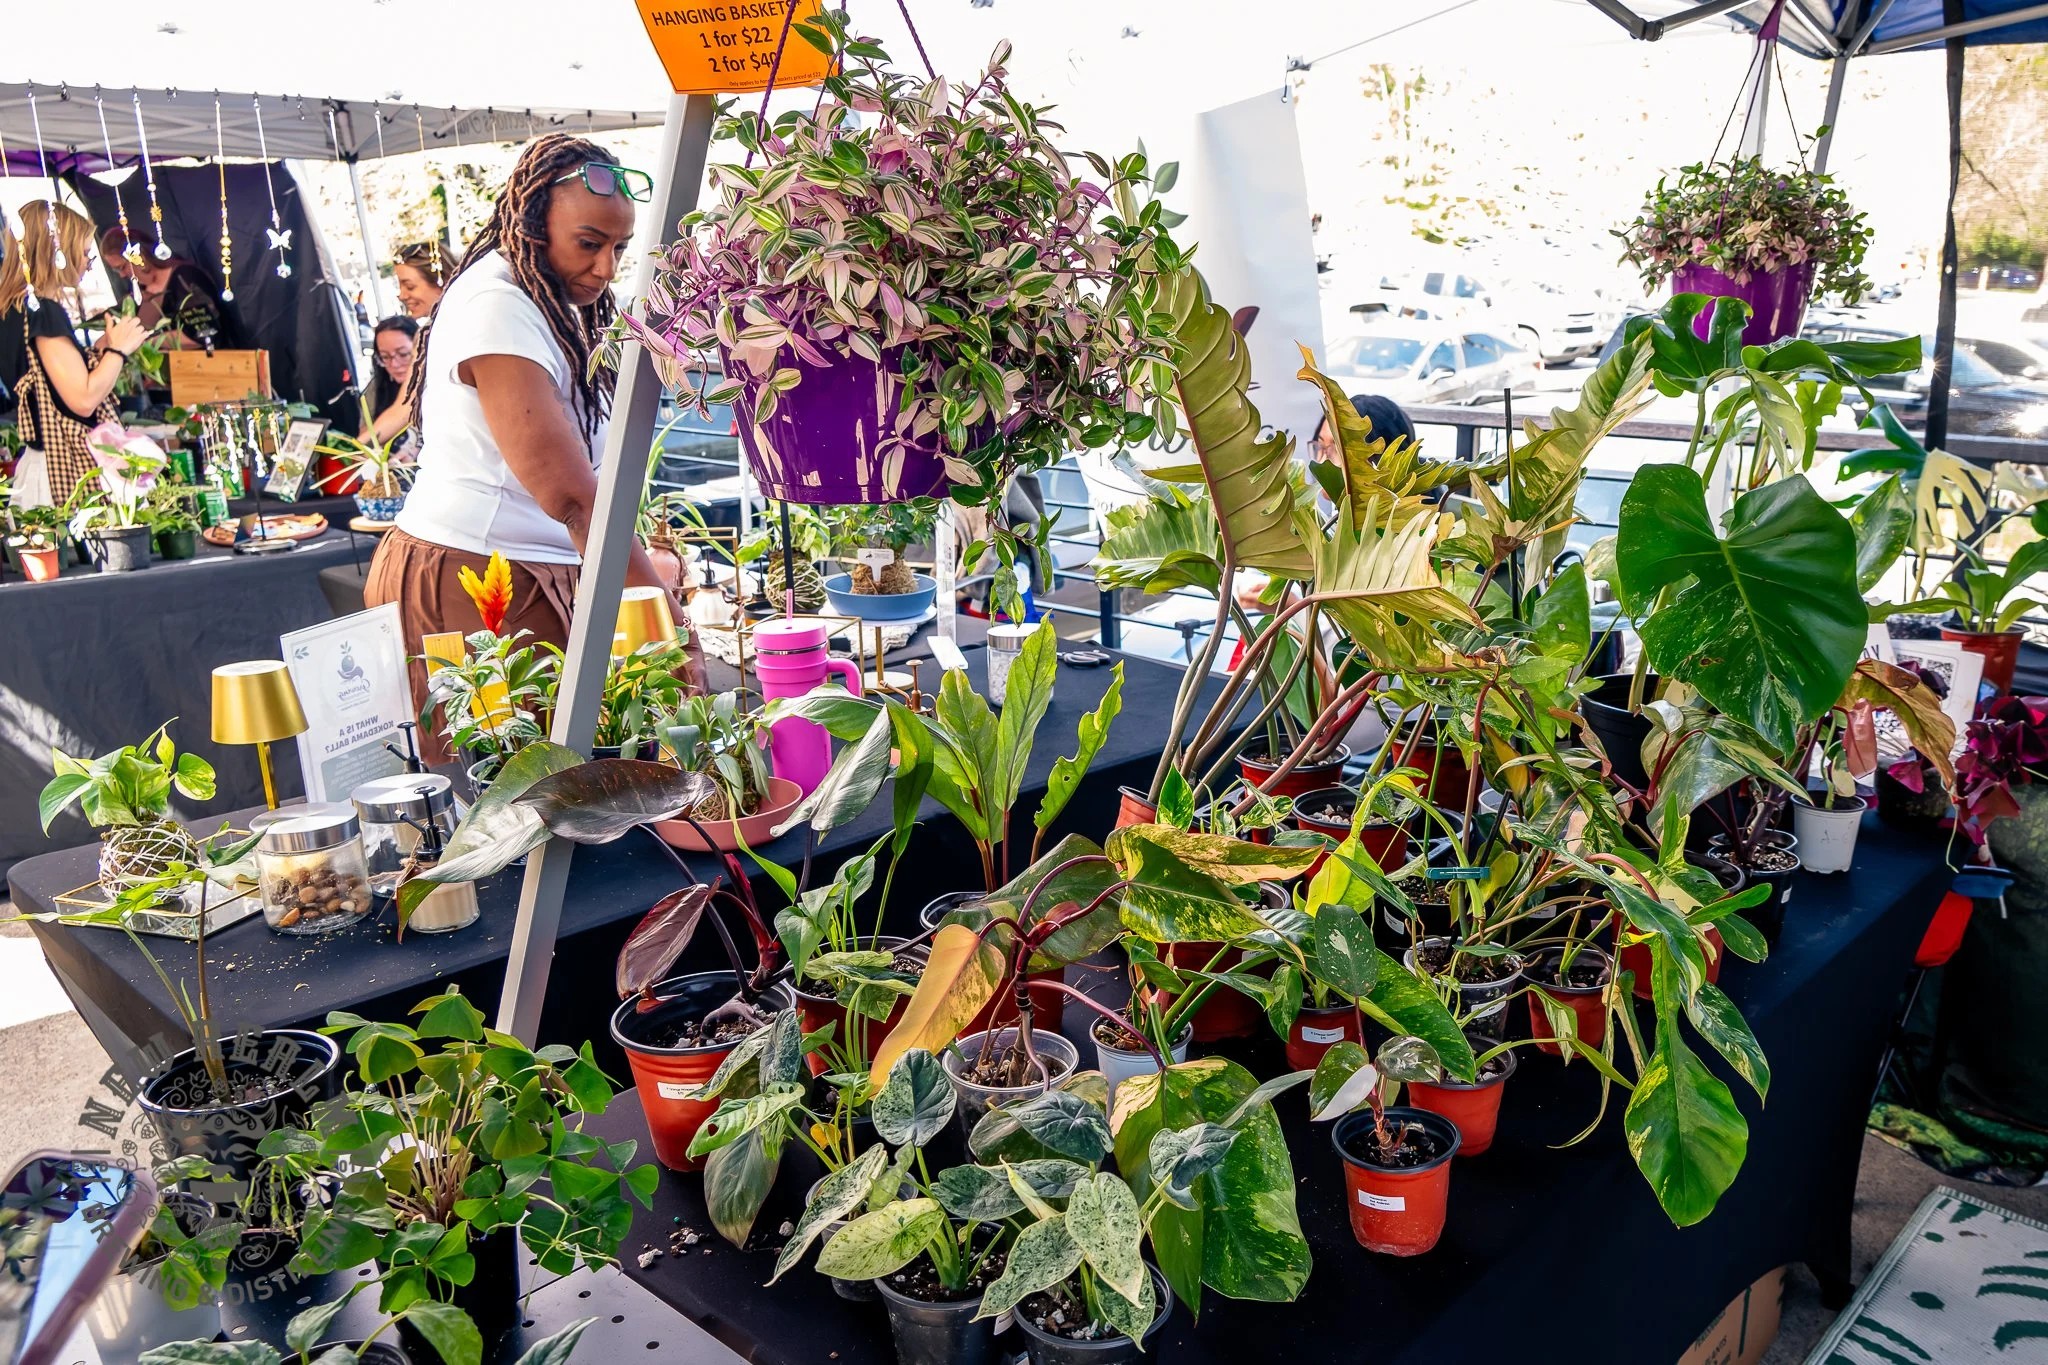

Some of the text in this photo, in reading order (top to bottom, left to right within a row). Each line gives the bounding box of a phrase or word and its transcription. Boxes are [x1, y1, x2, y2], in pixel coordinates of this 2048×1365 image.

[652, 7, 726, 27] HANGING
[699, 26, 773, 49] 1 for $22
[708, 57, 721, 73] 2
[722, 55, 746, 73] for
